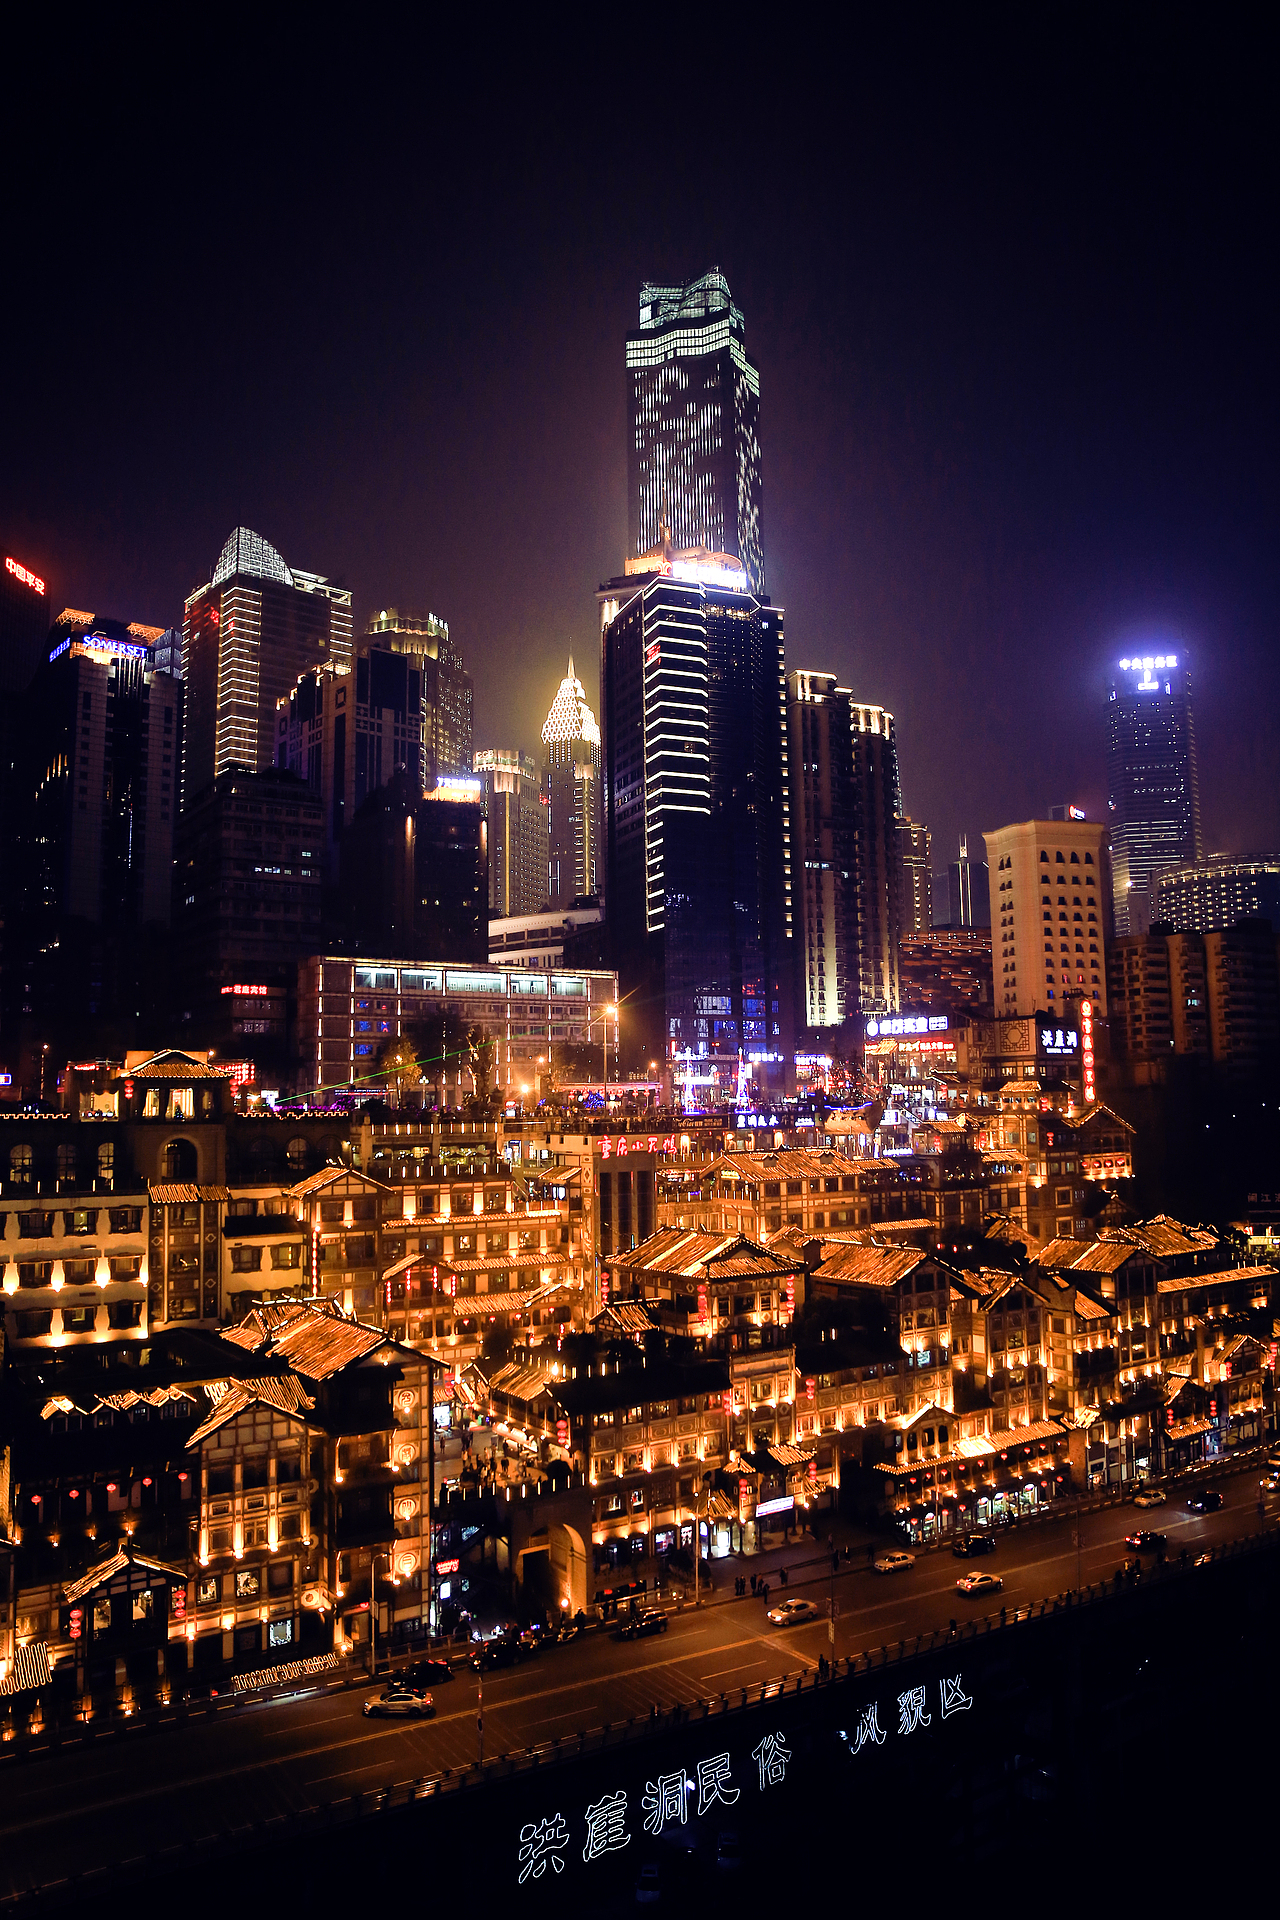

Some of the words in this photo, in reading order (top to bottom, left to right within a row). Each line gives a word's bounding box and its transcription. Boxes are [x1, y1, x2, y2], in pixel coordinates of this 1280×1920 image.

[5, 557, 45, 595] 中国平安
[83, 635, 147, 658] SOMERSET
[1119, 655, 1178, 671] 中央商务区
[477, 749, 494, 759] CCB
[1041, 1029, 1077, 1047] 洪崖洞
[597, 1133, 678, 1160] 重庆小天鹅
